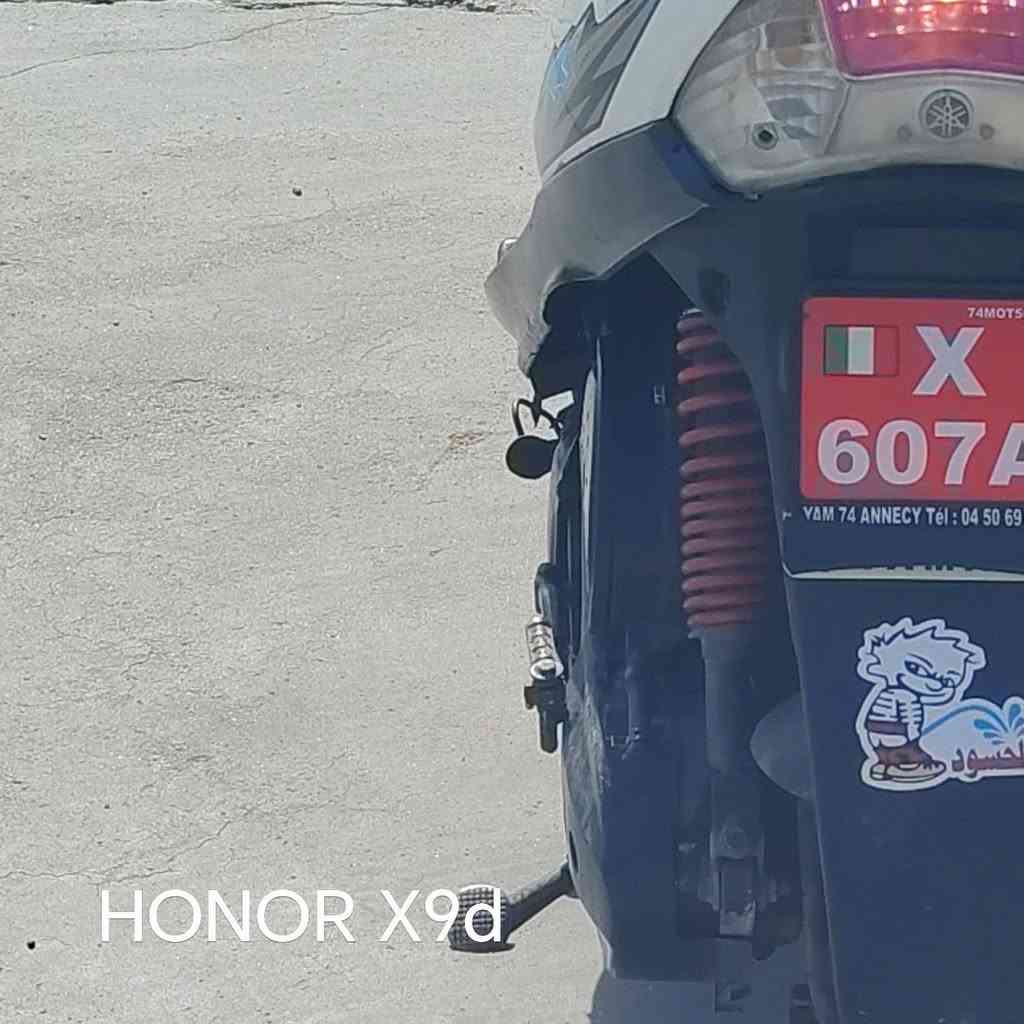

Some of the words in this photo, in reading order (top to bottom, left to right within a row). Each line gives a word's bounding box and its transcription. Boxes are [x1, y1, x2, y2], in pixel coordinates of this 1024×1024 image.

[912, 326, 987, 397] X
[803, 506, 834, 521] YAM
[838, 506, 857, 523] 74
[860, 506, 921, 525] ANNECY
[926, 507, 948, 525] Tél
[961, 507, 979, 526] 04
[983, 508, 1000, 526] 50
[1004, 508, 1022, 526] 69
